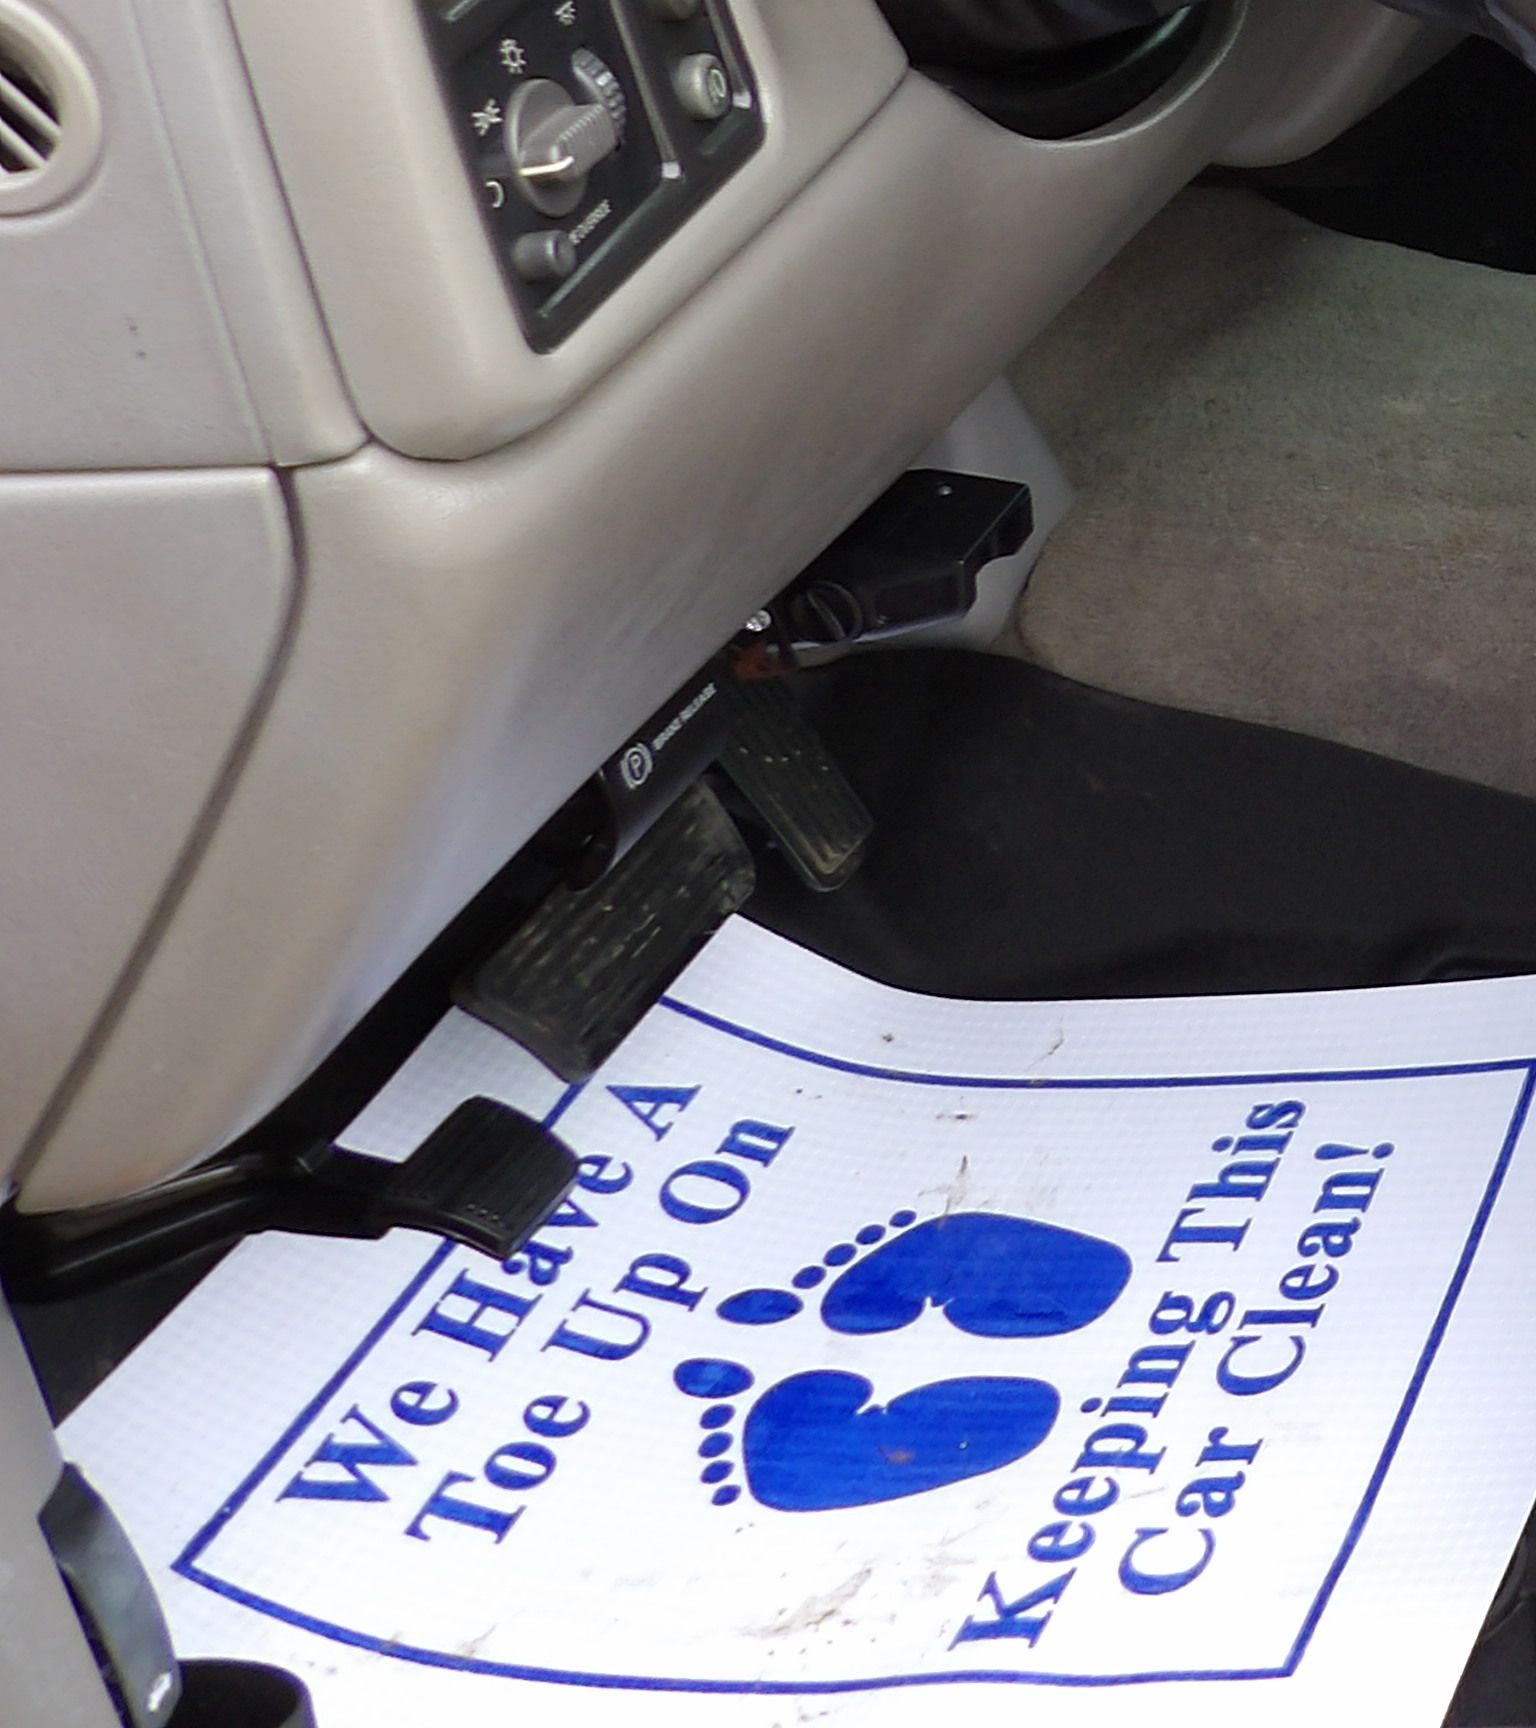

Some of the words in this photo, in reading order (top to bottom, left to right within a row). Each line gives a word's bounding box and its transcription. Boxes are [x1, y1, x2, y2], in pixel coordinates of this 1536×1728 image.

[678, 681, 718, 722] RELEASE
[275, 1380, 460, 1504] We
[411, 1154, 635, 1363] Have
[605, 1083, 703, 1142] A
[404, 1394, 591, 1545] Toe
[539, 1252, 709, 1362] Up
[659, 1118, 797, 1225] On
[947, 1290, 1237, 1652] Keeping
[1155, 1099, 1307, 1263] This
[1117, 1426, 1265, 1596] Car
[1215, 1141, 1396, 1397] Clean!
